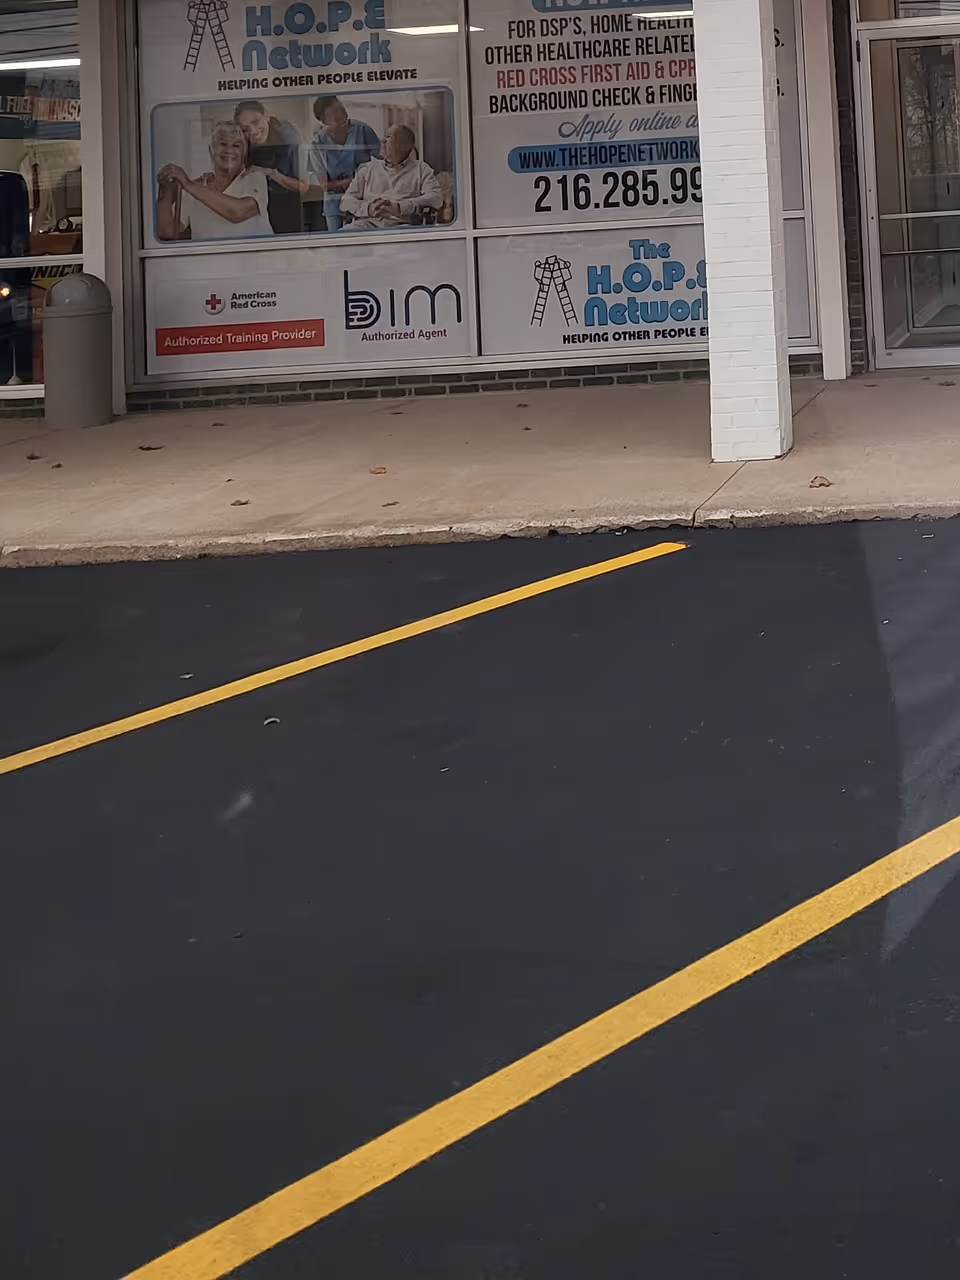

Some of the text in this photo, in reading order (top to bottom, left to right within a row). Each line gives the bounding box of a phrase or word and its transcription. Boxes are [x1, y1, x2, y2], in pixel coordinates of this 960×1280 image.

[508, 20, 536, 39] FOR
[540, 16, 587, 37] DSP'S,
[591, 13, 633, 34] HOME
[242, 32, 392, 72] Network
[485, 44, 533, 65] OTHER
[537, 38, 631, 62] HEALTHCARE
[218, 69, 417, 91] HELPING OTHER PEOPLE ELEVATE
[497, 69, 525, 89] RED
[530, 66, 577, 86] CROSS
[581, 63, 621, 83] FIRST
[626, 61, 650, 81] AID
[655, 61, 665, 78] &
[489, 90, 588, 114] BACKGROUND
[593, 86, 641, 107] CHECK
[645, 86, 655, 104] &
[558, 113, 623, 141] Apply
[629, 110, 682, 133] online
[629, 239, 671, 260] The
[230, 291, 277, 301] American
[230, 299, 277, 309] Red Cross
[164, 328, 316, 348] Authorized Training Provider
[361, 328, 447, 342] Authorized Agent
[563, 332, 608, 345] HELPING
[612, 330, 651, 342] OTHER
[654, 327, 696, 339] PEOPLE
